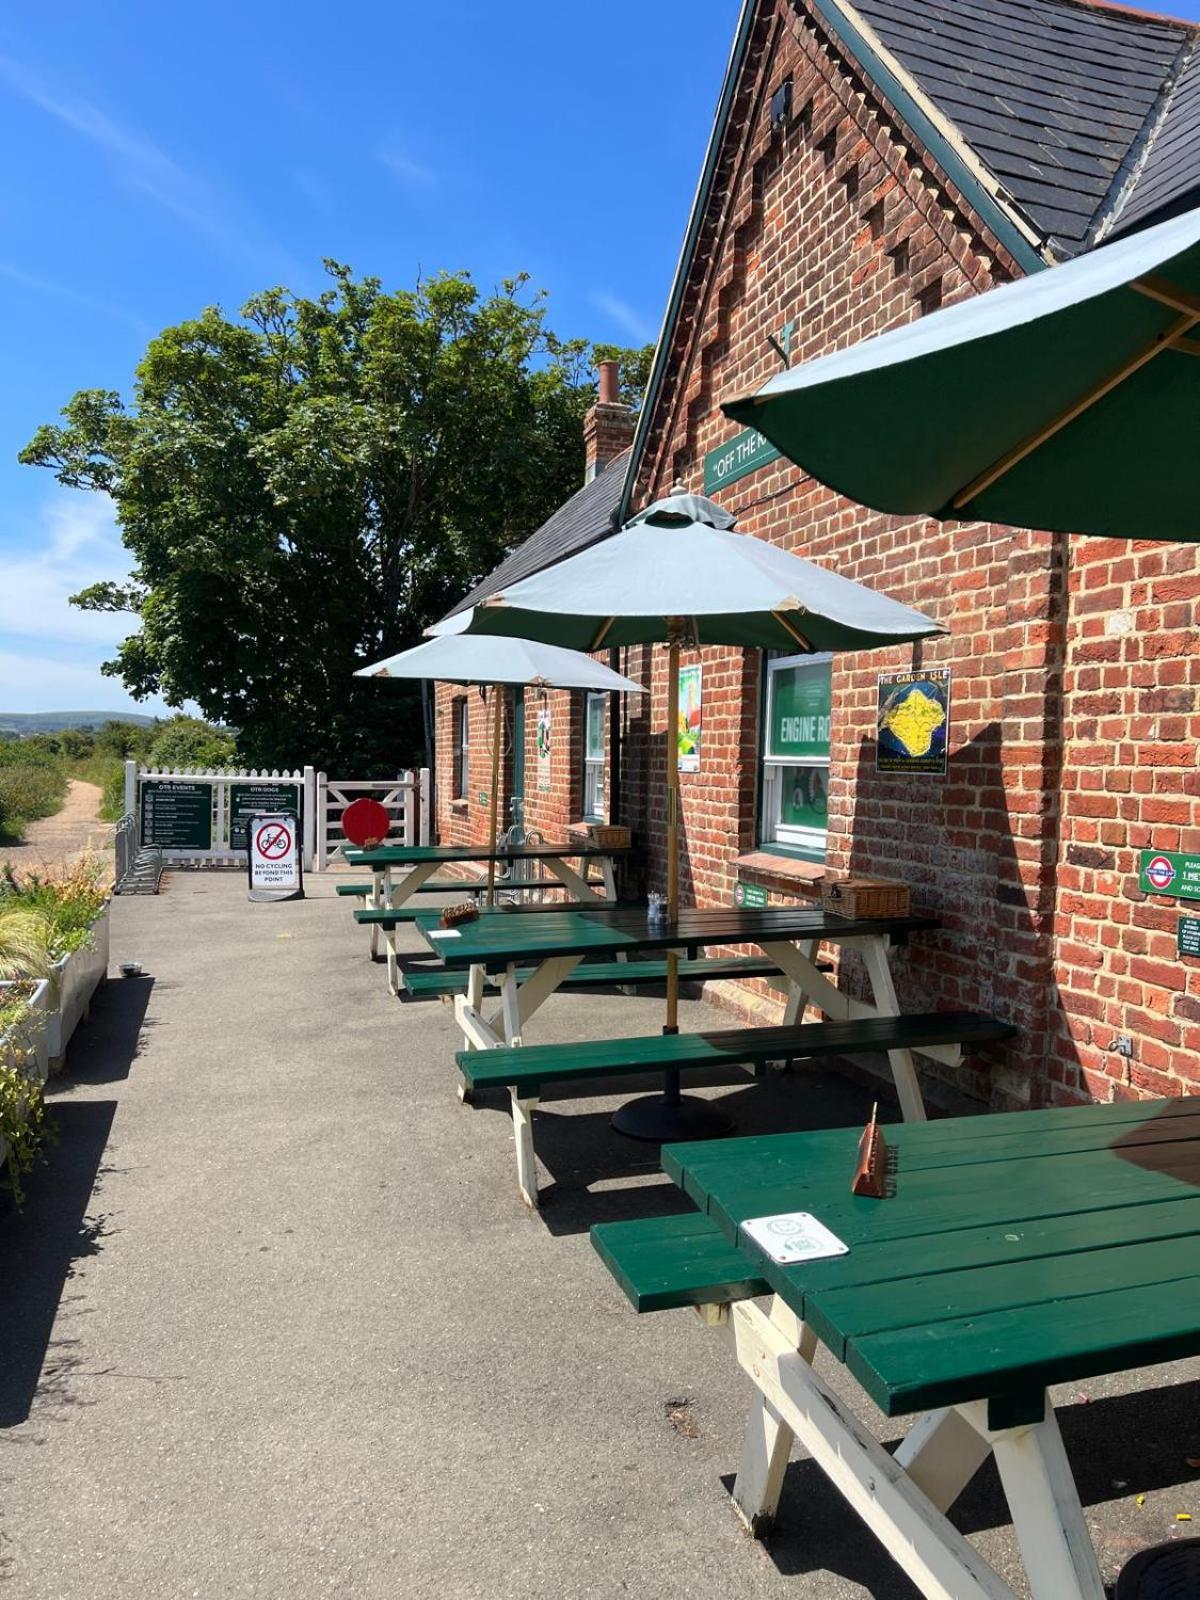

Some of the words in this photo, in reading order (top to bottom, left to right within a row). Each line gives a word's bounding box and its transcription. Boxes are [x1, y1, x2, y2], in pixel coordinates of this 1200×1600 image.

[736, 434, 756, 463] THE
[880, 675, 893, 685] THE
[930, 670, 948, 681] ISLE
[781, 716, 816, 743] ENGINE
